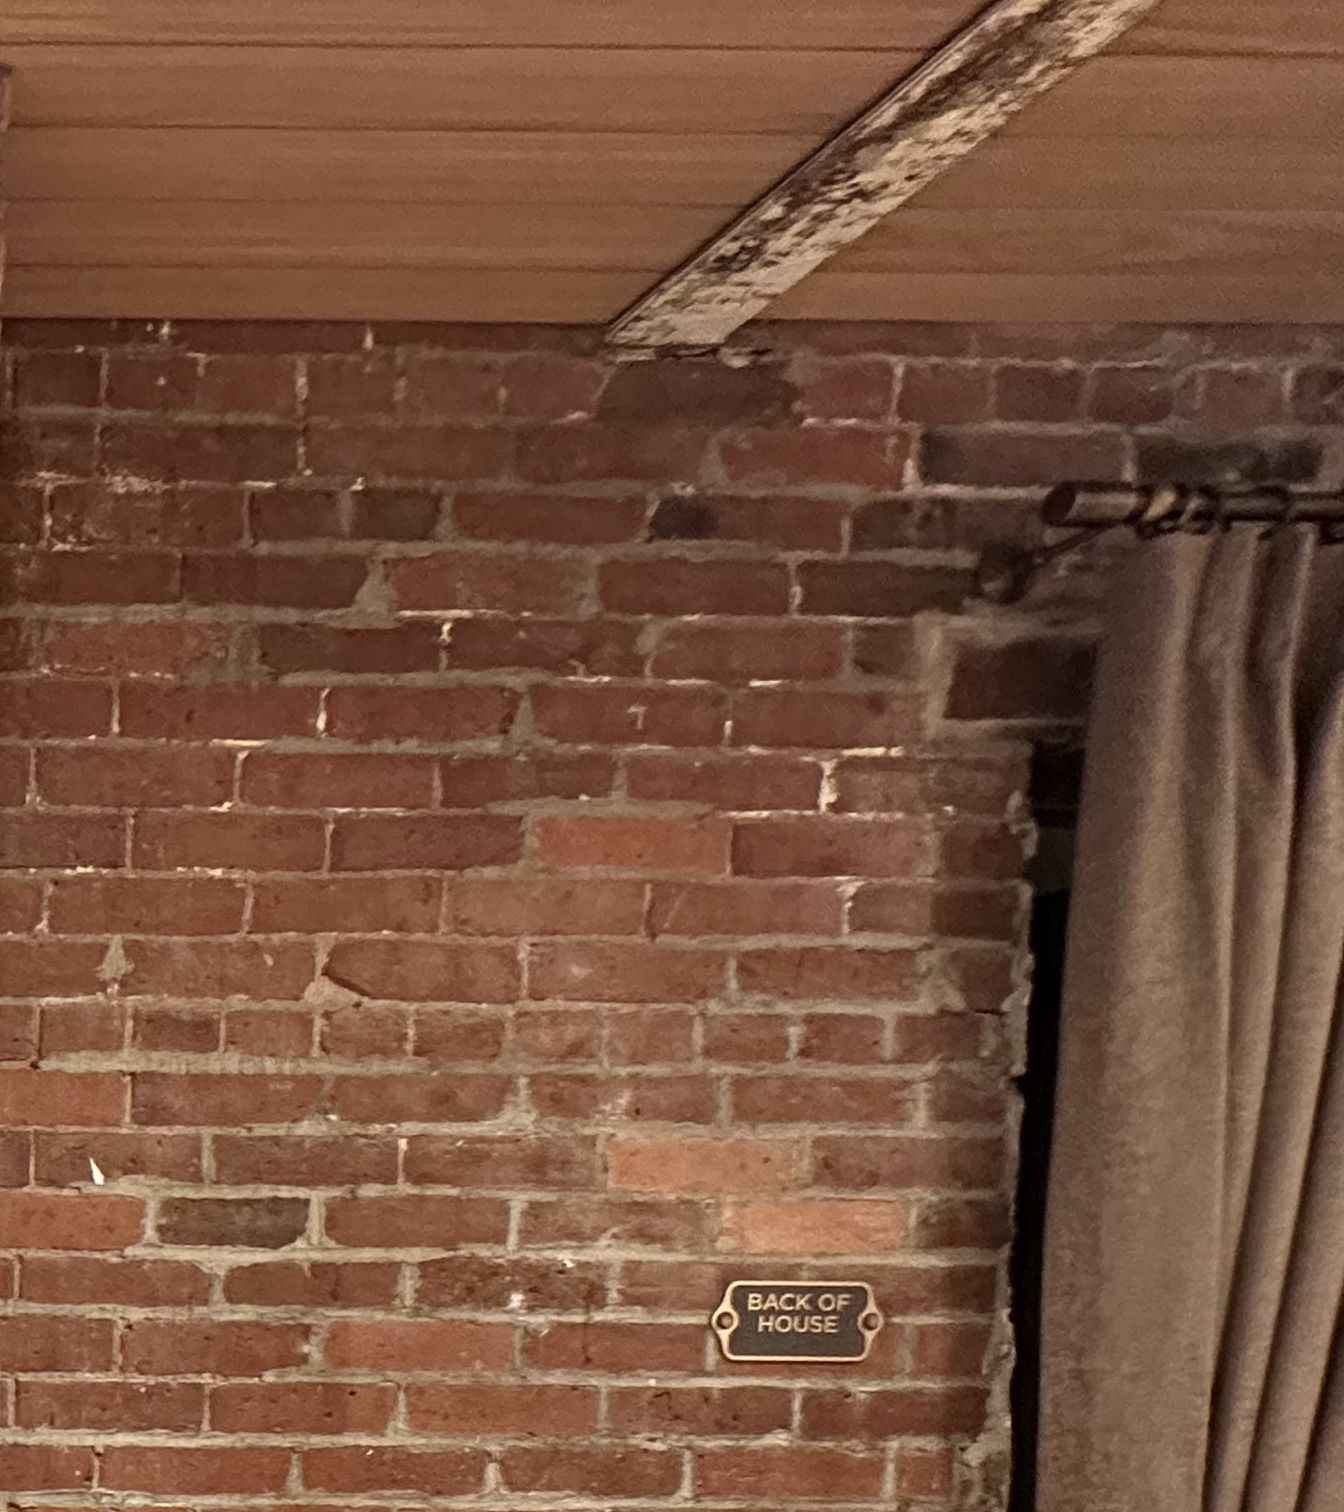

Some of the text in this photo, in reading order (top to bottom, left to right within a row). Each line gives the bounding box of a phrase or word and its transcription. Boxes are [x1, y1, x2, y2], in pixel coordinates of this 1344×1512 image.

[747, 1293, 851, 1312] BACK OF
[758, 1315, 840, 1333] HOUSE
